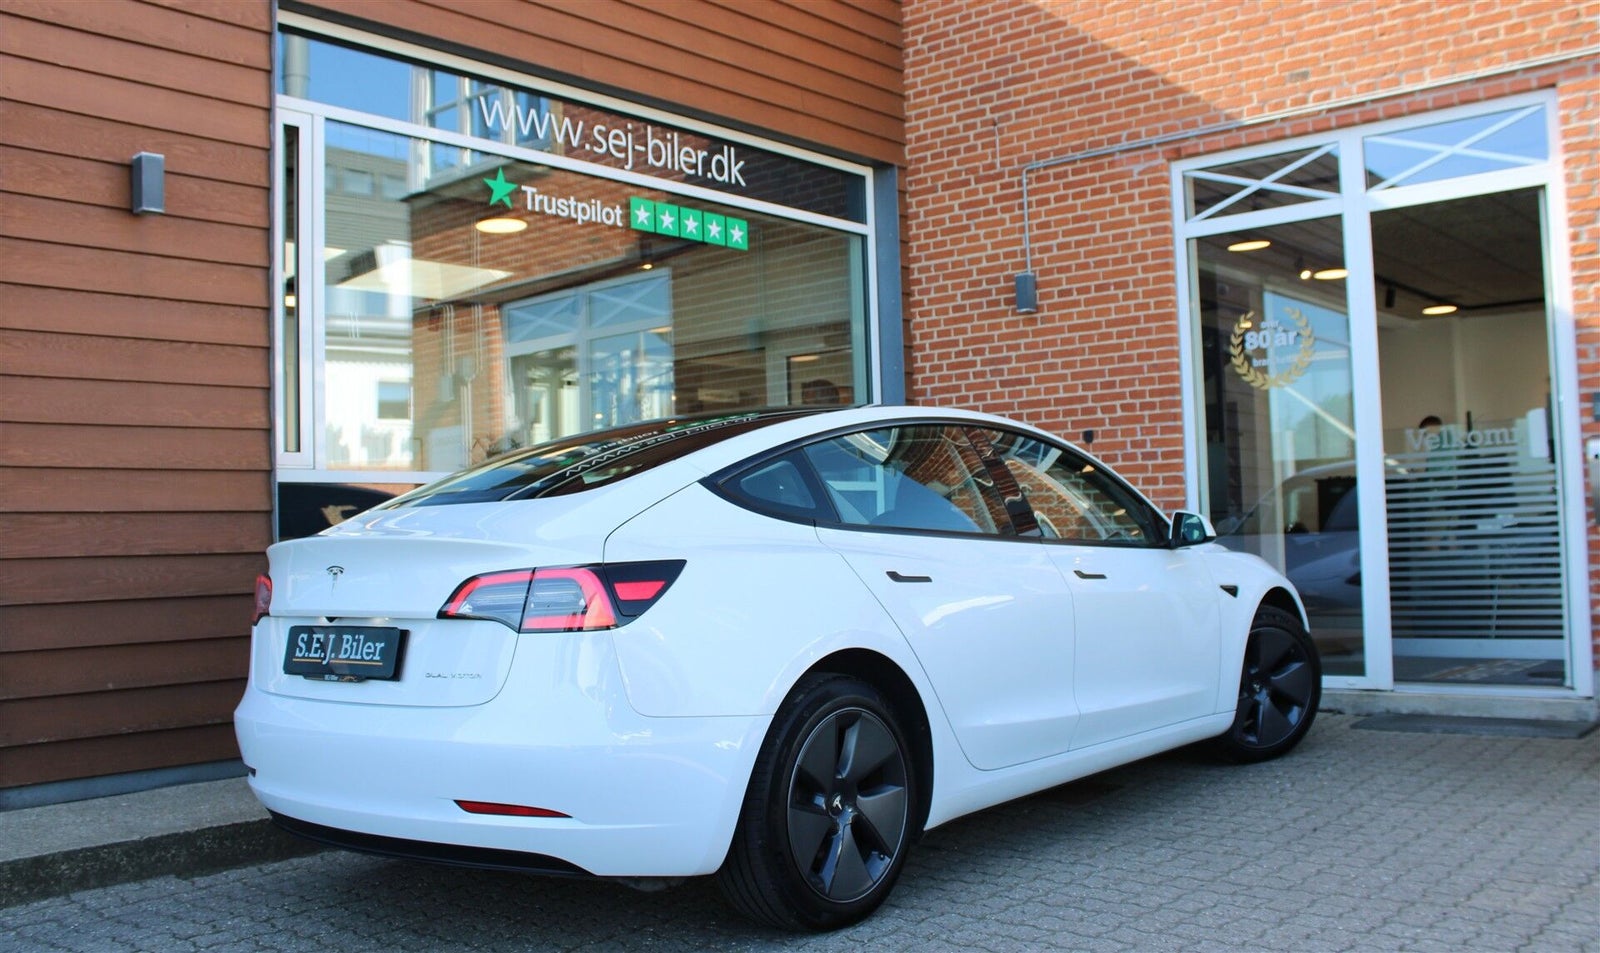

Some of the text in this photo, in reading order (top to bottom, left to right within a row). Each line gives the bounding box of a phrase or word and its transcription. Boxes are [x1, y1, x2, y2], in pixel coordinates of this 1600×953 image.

[480, 96, 746, 187] www.sej-biler.dk
[521, 185, 623, 227] Trustpilot
[1244, 326, 1298, 350] 80 år
[295, 633, 385, 665] S.E.J. Biler
